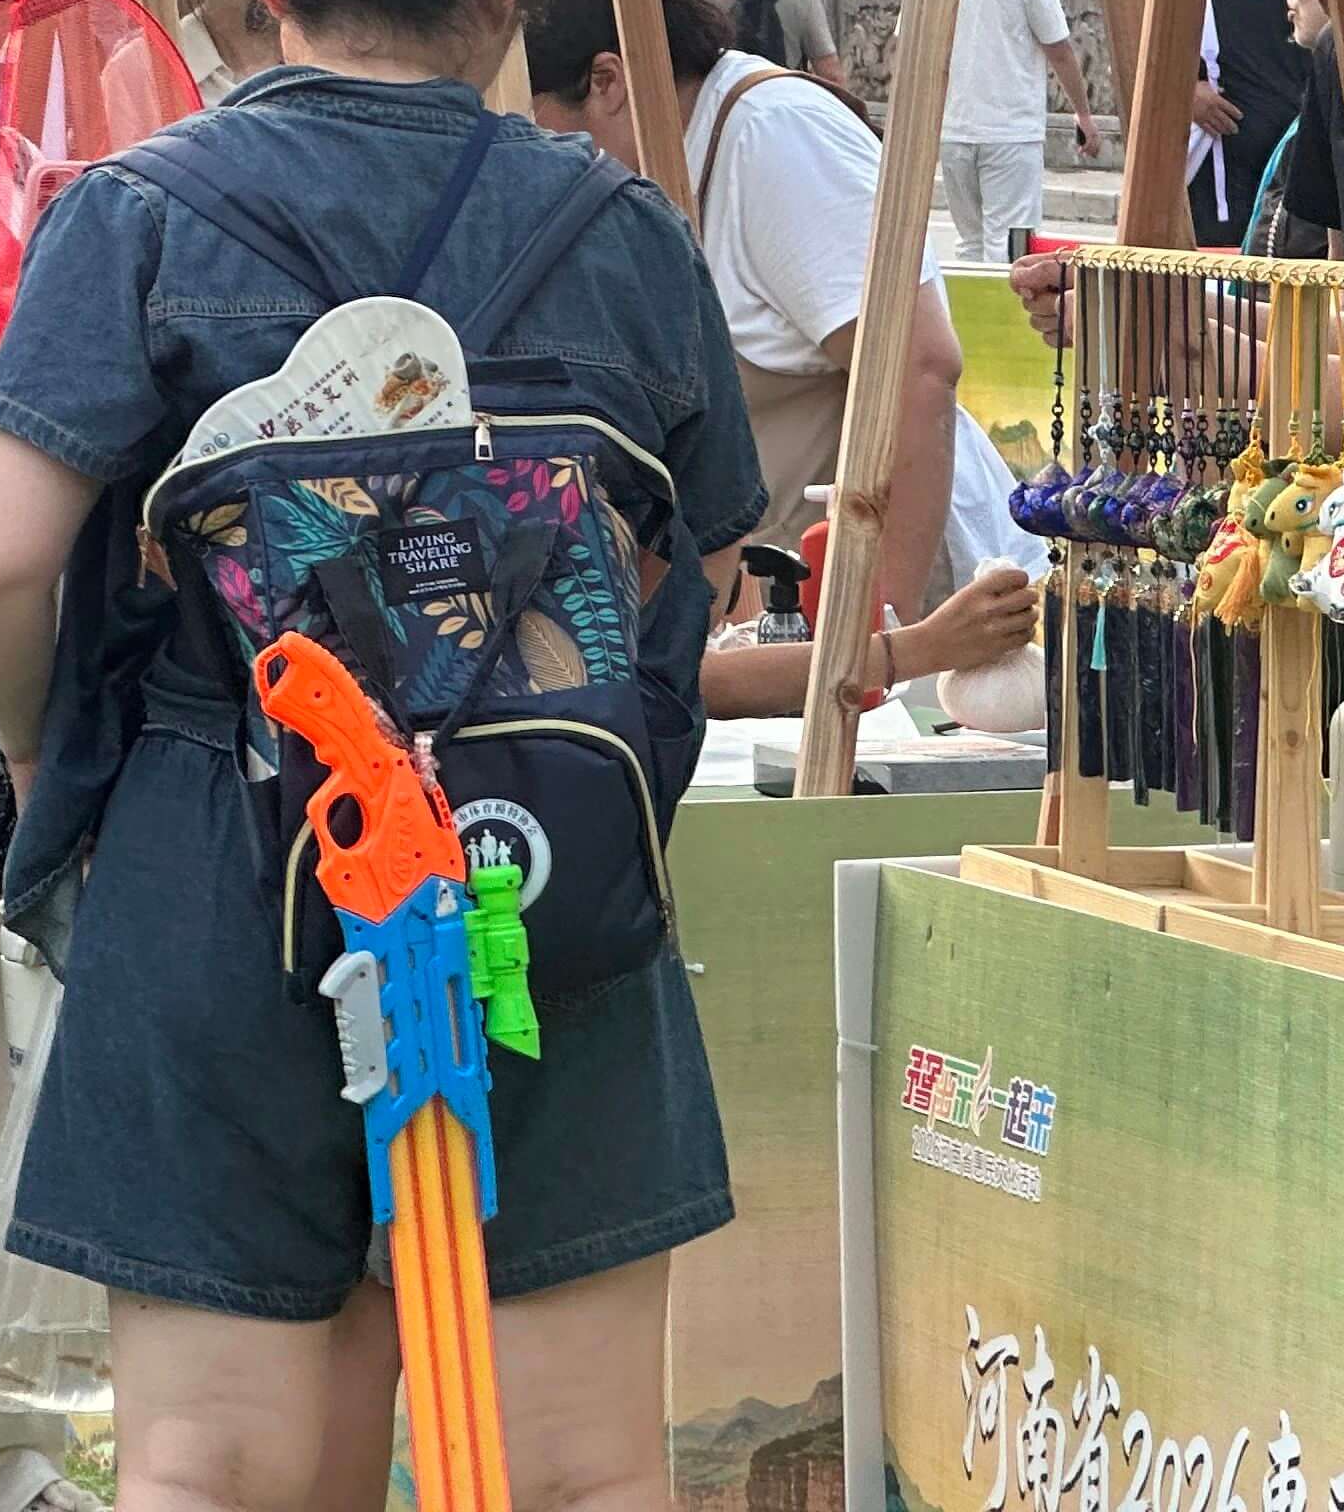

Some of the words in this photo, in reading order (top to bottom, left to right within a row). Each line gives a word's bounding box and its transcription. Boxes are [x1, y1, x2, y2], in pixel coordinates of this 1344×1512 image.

[399, 532, 456, 551] LIVING
[387, 541, 472, 565] TRAVELING
[405, 555, 460, 575] SHARE
